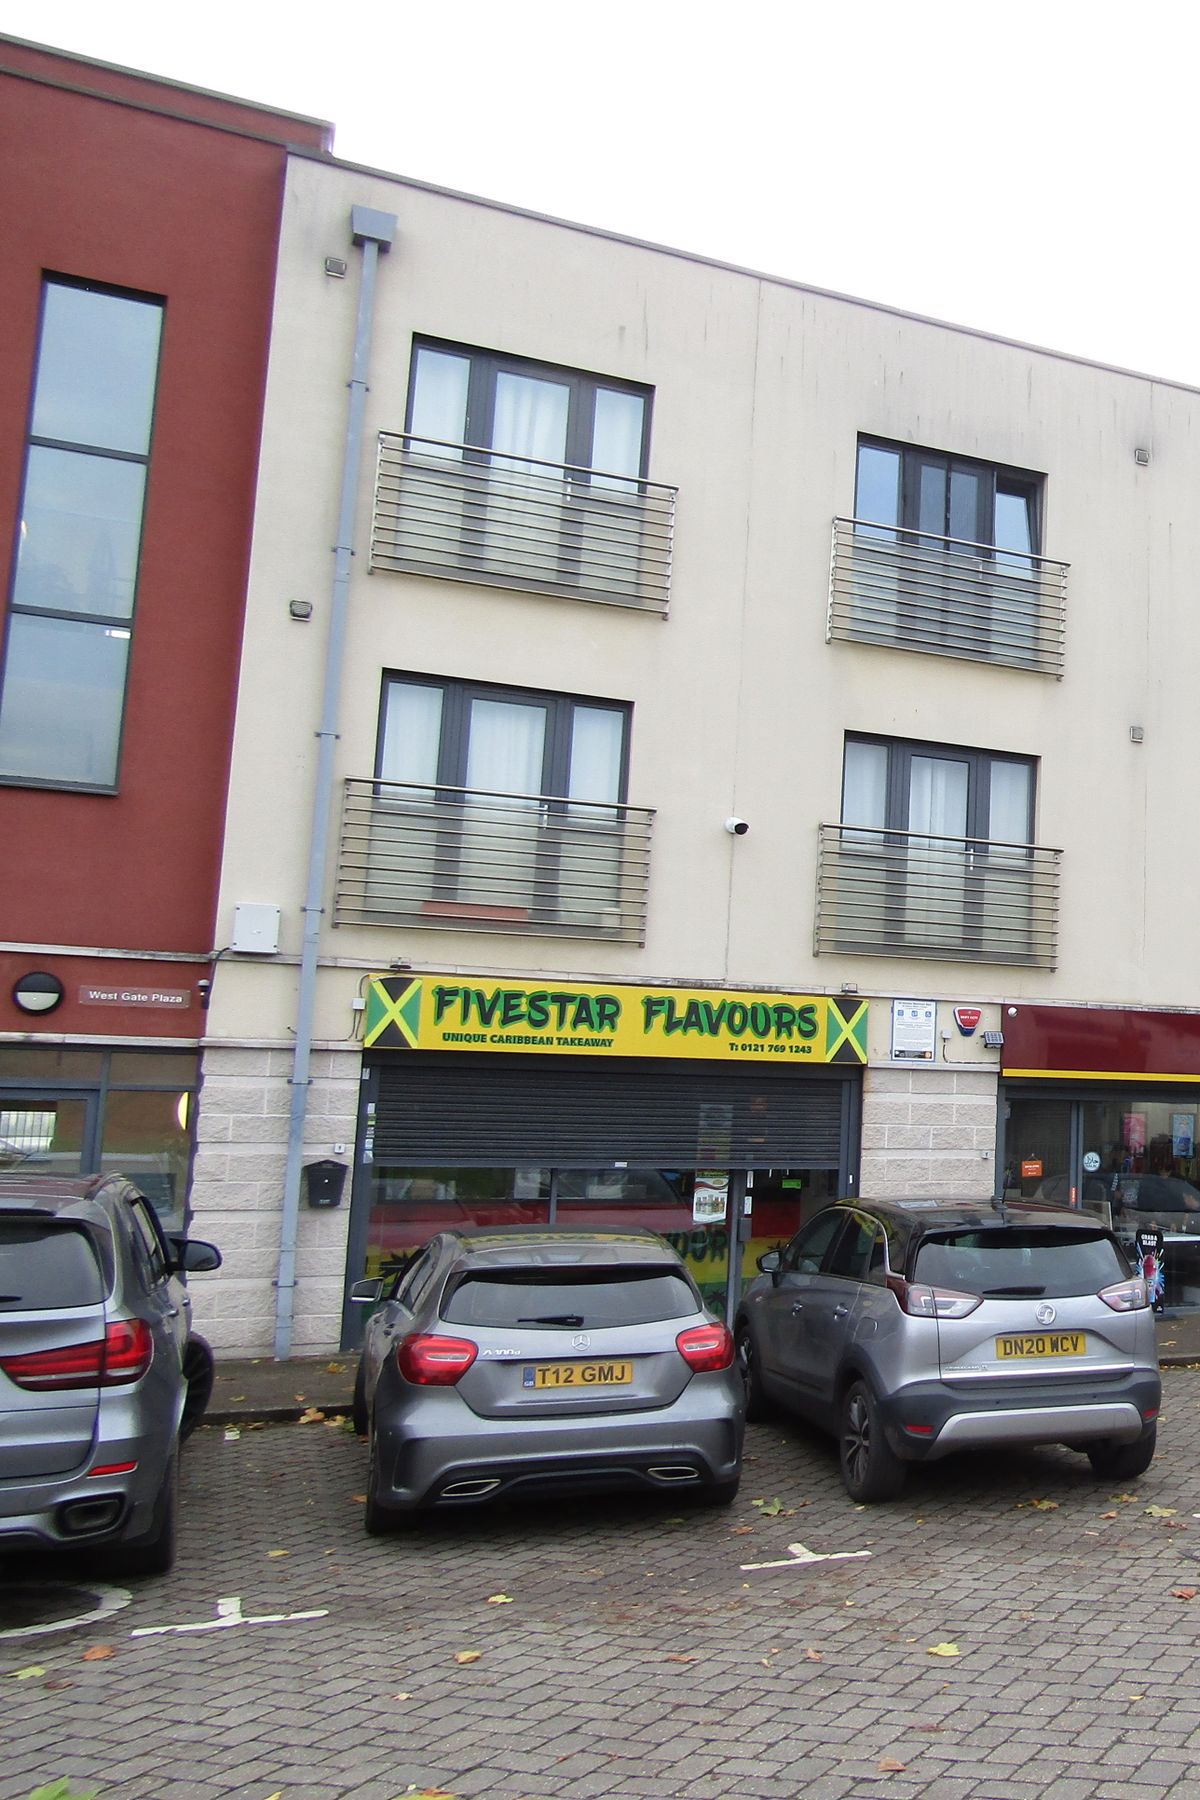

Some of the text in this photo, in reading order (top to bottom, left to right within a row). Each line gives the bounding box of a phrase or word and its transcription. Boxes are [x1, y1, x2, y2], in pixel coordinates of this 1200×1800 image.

[89, 991, 183, 1003] West Gate Plaza
[432, 985, 819, 1041] FIVESTAR FLAVOURS
[442, 1032, 614, 1048] UNIQUE CARIBBEAN TAKEAWAY
[729, 1042, 812, 1054] T: 0121 769 1243
[1003, 1336, 1080, 1356] DN20 WCV
[538, 1365, 625, 1385] T12 GMJ
